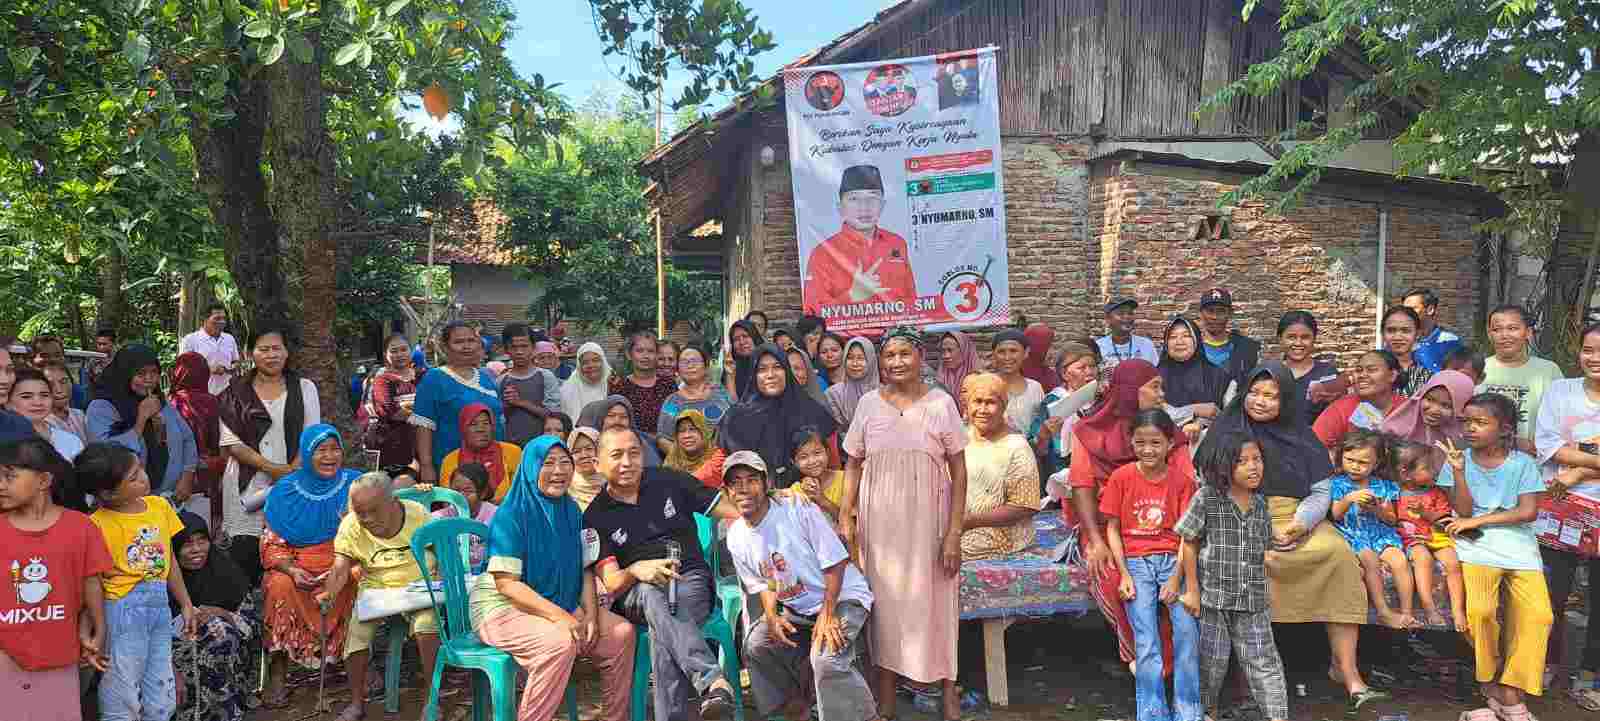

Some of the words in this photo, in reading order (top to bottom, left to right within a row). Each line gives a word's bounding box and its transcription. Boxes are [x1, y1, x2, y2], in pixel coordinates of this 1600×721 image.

[979, 207, 994, 218] SM
[915, 297, 936, 311] SM
[955, 282, 978, 313] 3
[0, 604, 65, 624] MIXUE
